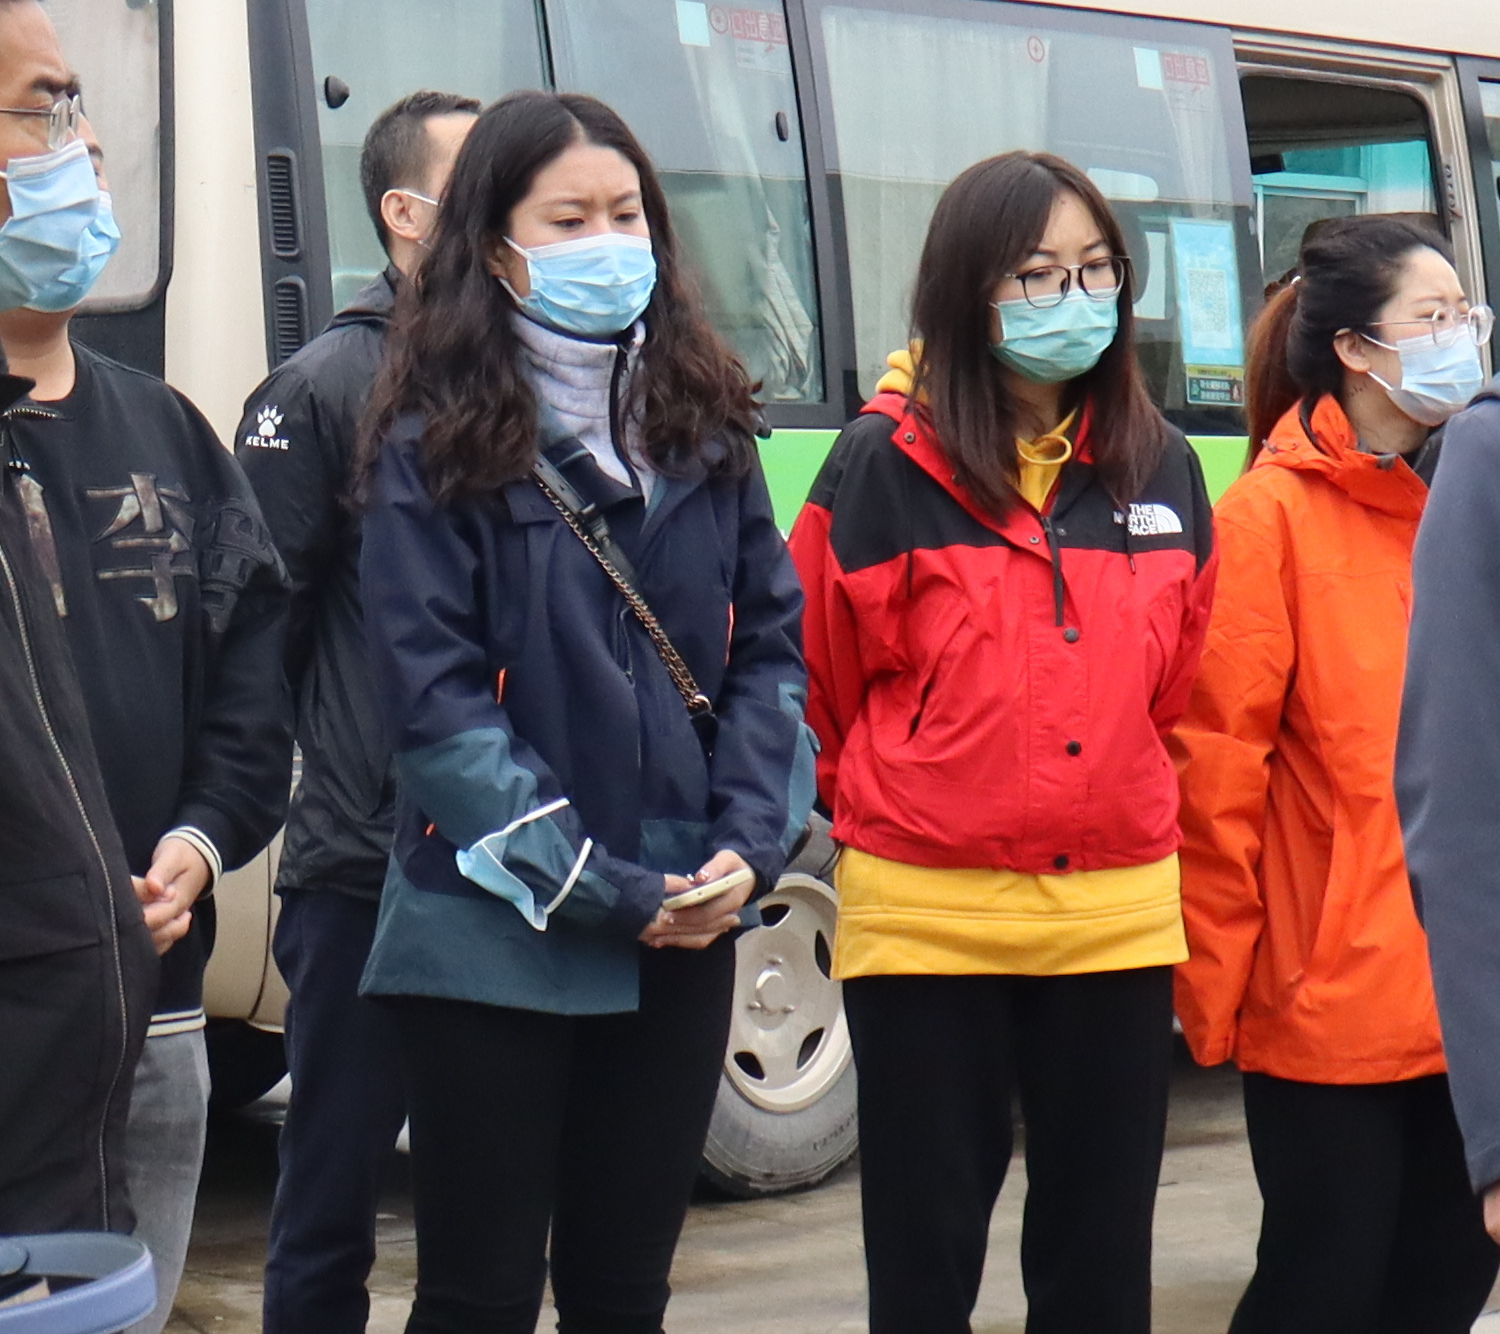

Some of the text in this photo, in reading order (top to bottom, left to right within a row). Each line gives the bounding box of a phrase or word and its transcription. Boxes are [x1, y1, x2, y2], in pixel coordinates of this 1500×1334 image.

[245, 436, 290, 450] KELME
[1128, 503, 1154, 515] THE
[1112, 511, 1156, 525] NRTH
